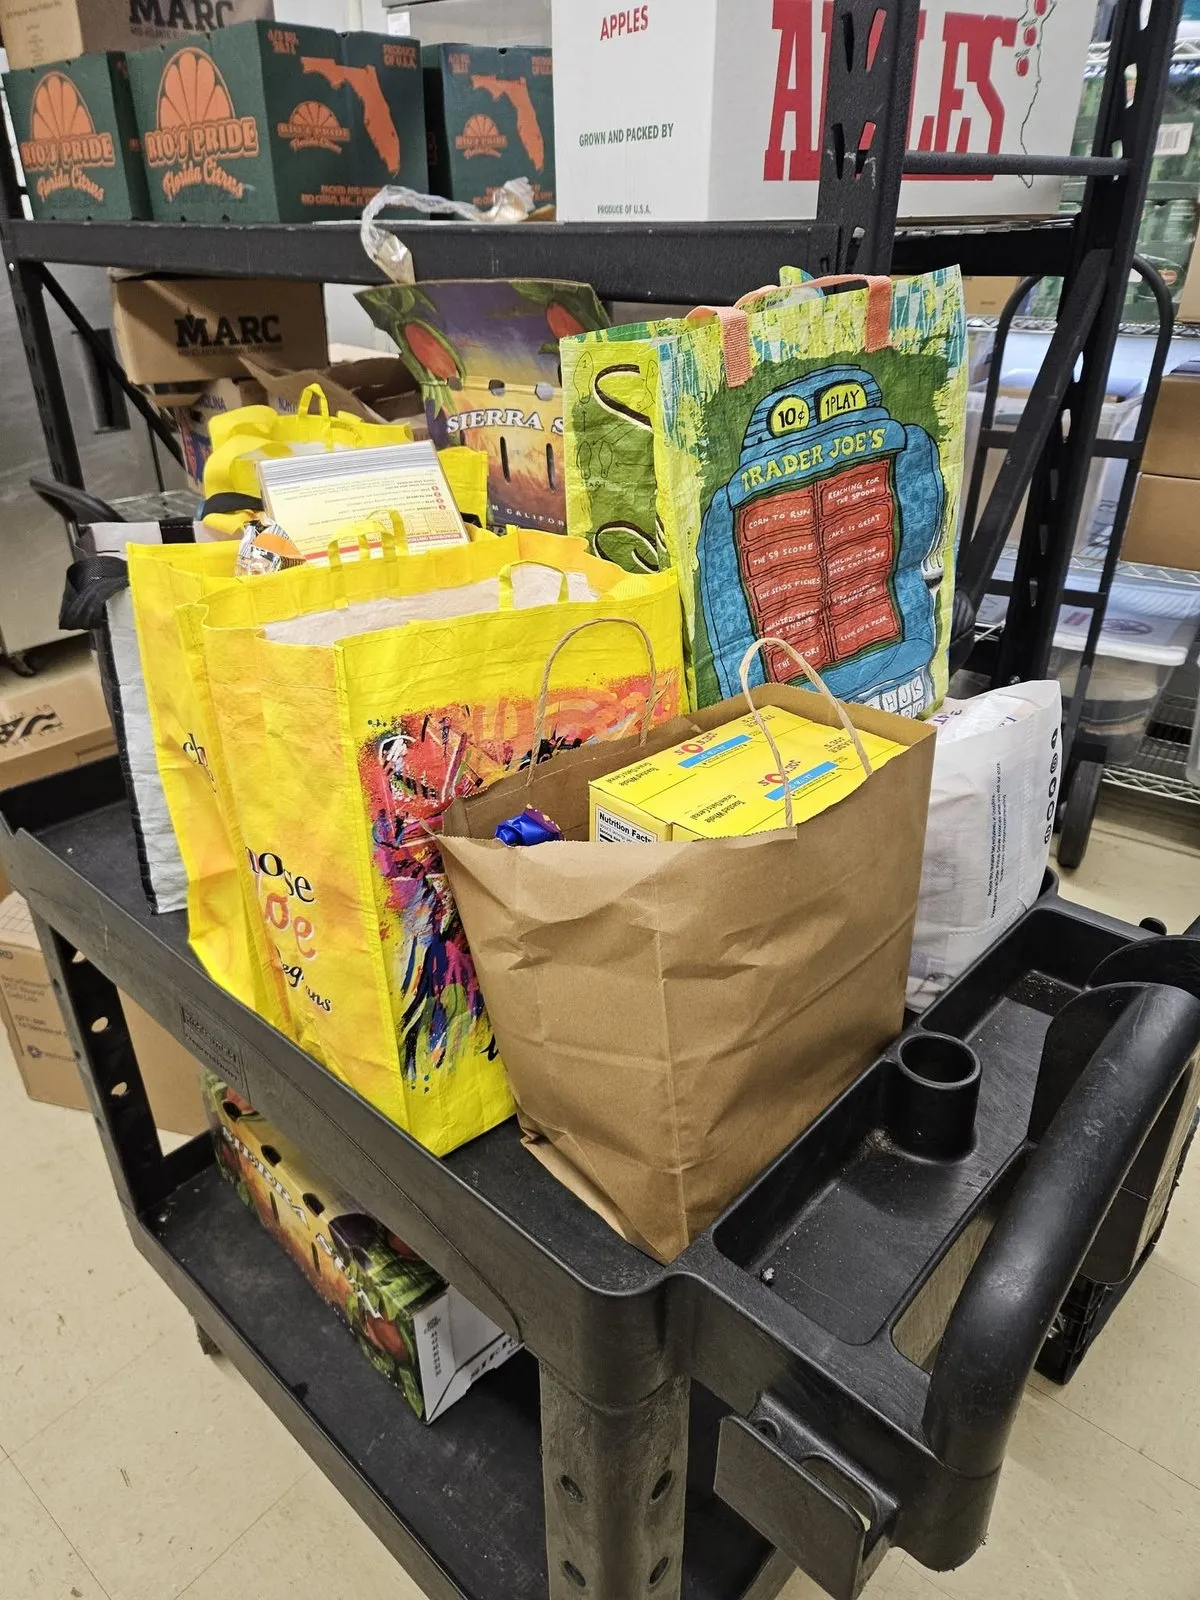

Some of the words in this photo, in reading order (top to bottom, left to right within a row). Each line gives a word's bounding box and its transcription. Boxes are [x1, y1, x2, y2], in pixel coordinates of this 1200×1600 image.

[600, 5, 649, 41] APPLES
[145, 128, 191, 167] RIO'S
[191, 116, 259, 160] PRIDE
[579, 131, 606, 147] GROWN
[607, 129, 624, 144] AND
[626, 125, 659, 142] PACKED
[661, 123, 674, 138] BY
[21, 141, 61, 172] RIO'S
[61, 132, 115, 167] PRIDE
[163, 161, 202, 202] Florida
[202, 156, 244, 198] Citrus
[598, 205, 624, 215] PRODUCE
[625, 205, 632, 214] OF
[174, 311, 282, 347] MARC
[447, 408, 544, 433] SIERRA
[741, 444, 825, 492] TRADER
[829, 428, 886, 459] JOE'S
[828, 482, 863, 500] REACHING
[866, 476, 880, 486] FOR
[836, 496, 849, 506] THE
[852, 488, 876, 500] SPOON
[749, 518, 769, 529] CORN
[790, 508, 811, 519] RUN
[858, 514, 880, 528] GREAT
[752, 556, 766, 566] THE
[782, 543, 814, 556] SCONE
[758, 592, 770, 600] SHE
[600, 812, 630, 834] Nutrition
[704, 811, 724, 823] Whole
[245, 847, 315, 902] ose
[220, 1125, 311, 1232] SIERRA
